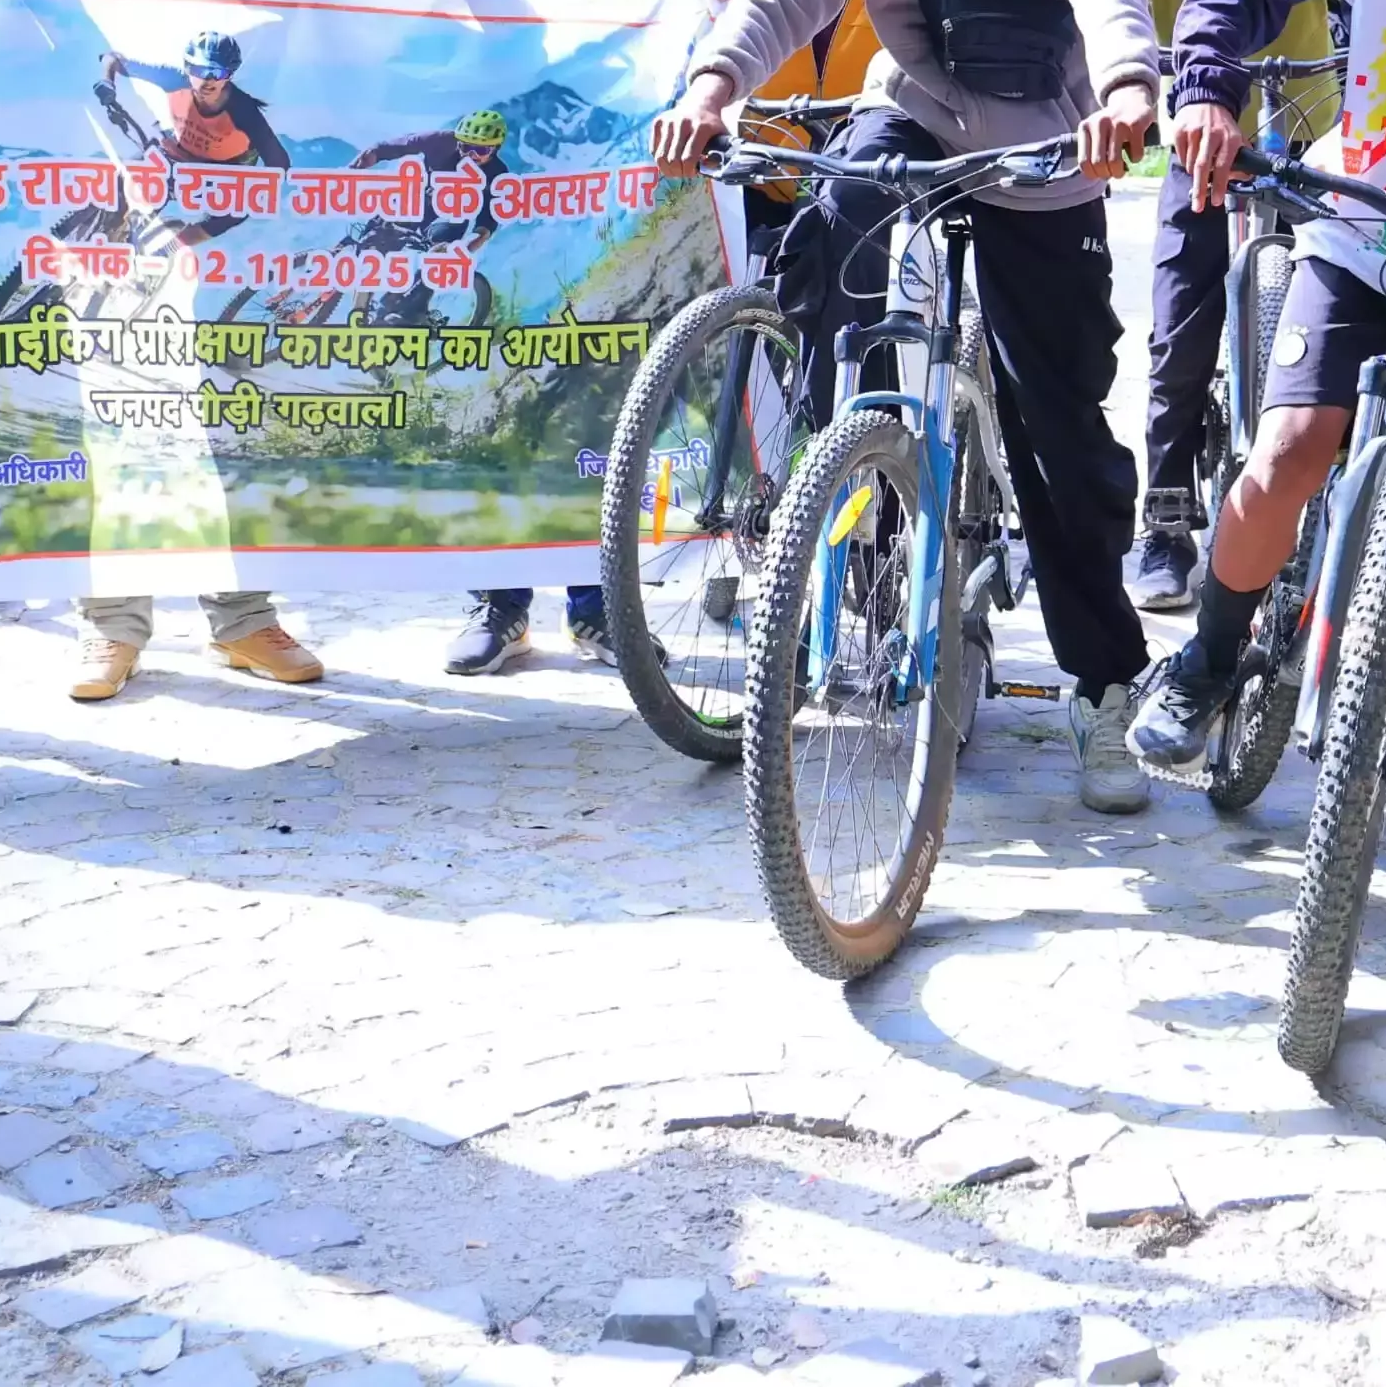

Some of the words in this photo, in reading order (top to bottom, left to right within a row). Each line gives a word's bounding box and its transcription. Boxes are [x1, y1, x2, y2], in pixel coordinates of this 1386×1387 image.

[19, 160, 117, 208] राज्य
[119, 153, 168, 206] के
[177, 166, 280, 215] रजत
[292, 160, 425, 217] जयन्ती
[433, 165, 483, 219] के
[493, 170, 612, 221] अवसर
[615, 165, 660, 210] पर
[21, 234, 132, 281] दिनांक
[425, 244, 475, 290] को
[131, 306, 267, 367] प्रशिक्षण
[275, 311, 430, 370] कार्यक्रम
[439, 325, 495, 370] का
[501, 307, 651, 367] आयोजन
[91, 390, 185, 428] जनपद
[188, 380, 264, 434] पौड़ी
[895, 829, 935, 920] MERIDA
